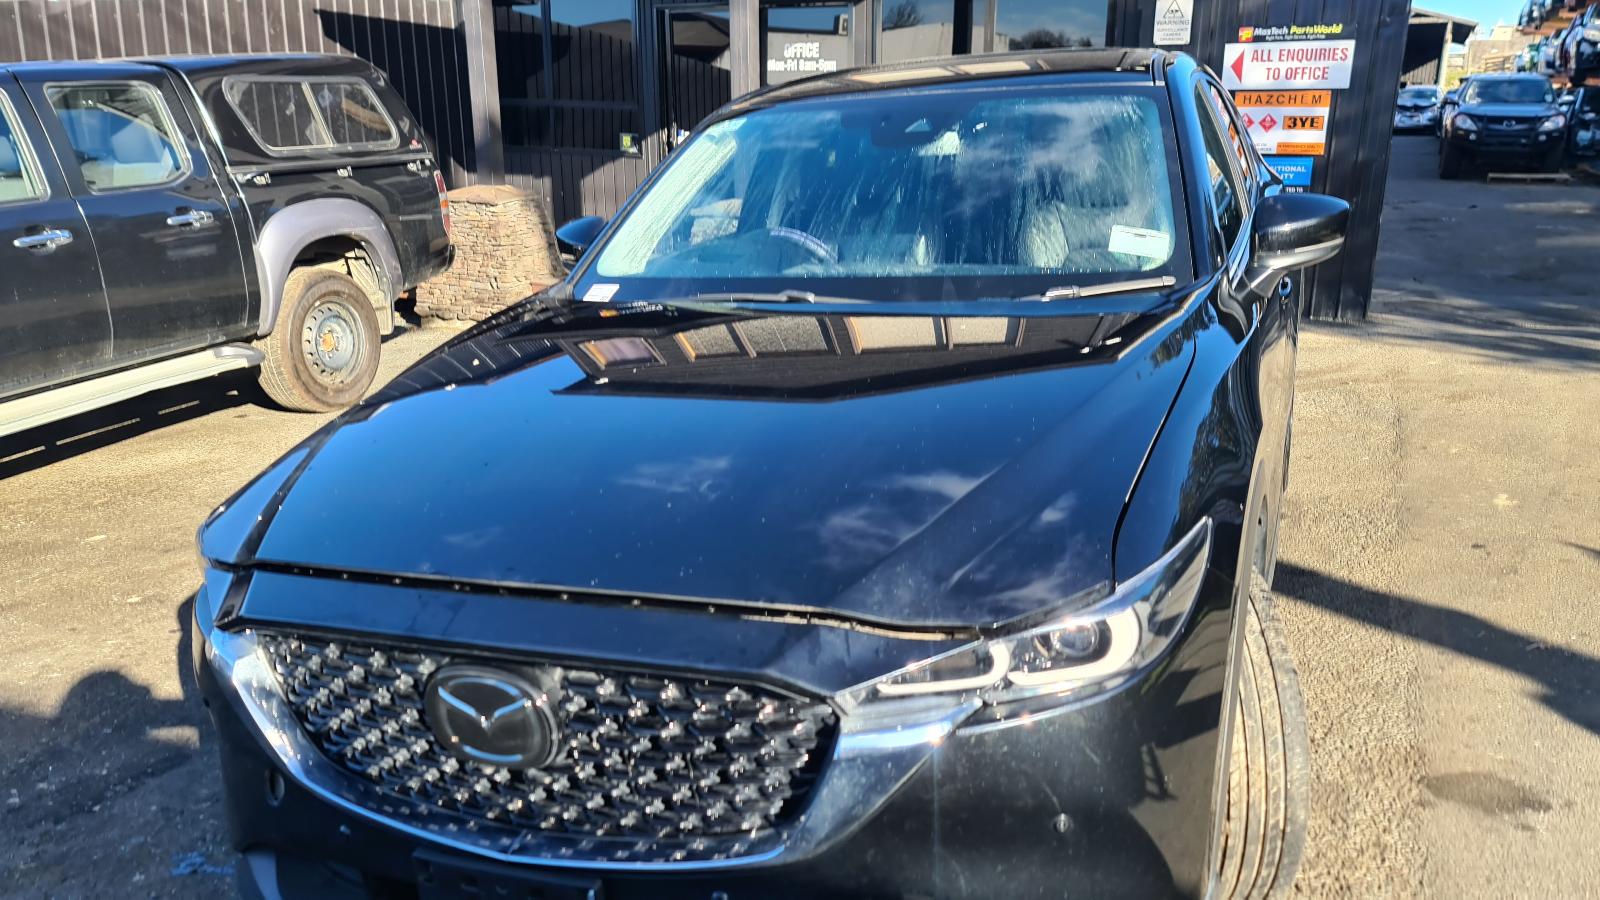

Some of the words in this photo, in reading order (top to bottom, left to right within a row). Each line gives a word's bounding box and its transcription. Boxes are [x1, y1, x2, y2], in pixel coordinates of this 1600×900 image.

[1290, 23, 1343, 35] PartsWorld
[784, 42, 820, 58] OFFICE
[1251, 49, 1273, 62] ALL
[1278, 48, 1349, 63] ENQUIRIES
[767, 58, 798, 71] Mon-Fri
[799, 58, 837, 72] 8am-5pm
[1266, 67, 1281, 80] TO
[1285, 67, 1330, 80] OFFICE
[1243, 94, 1322, 105] HAZCHEM
[1288, 117, 1320, 128] 3YE
